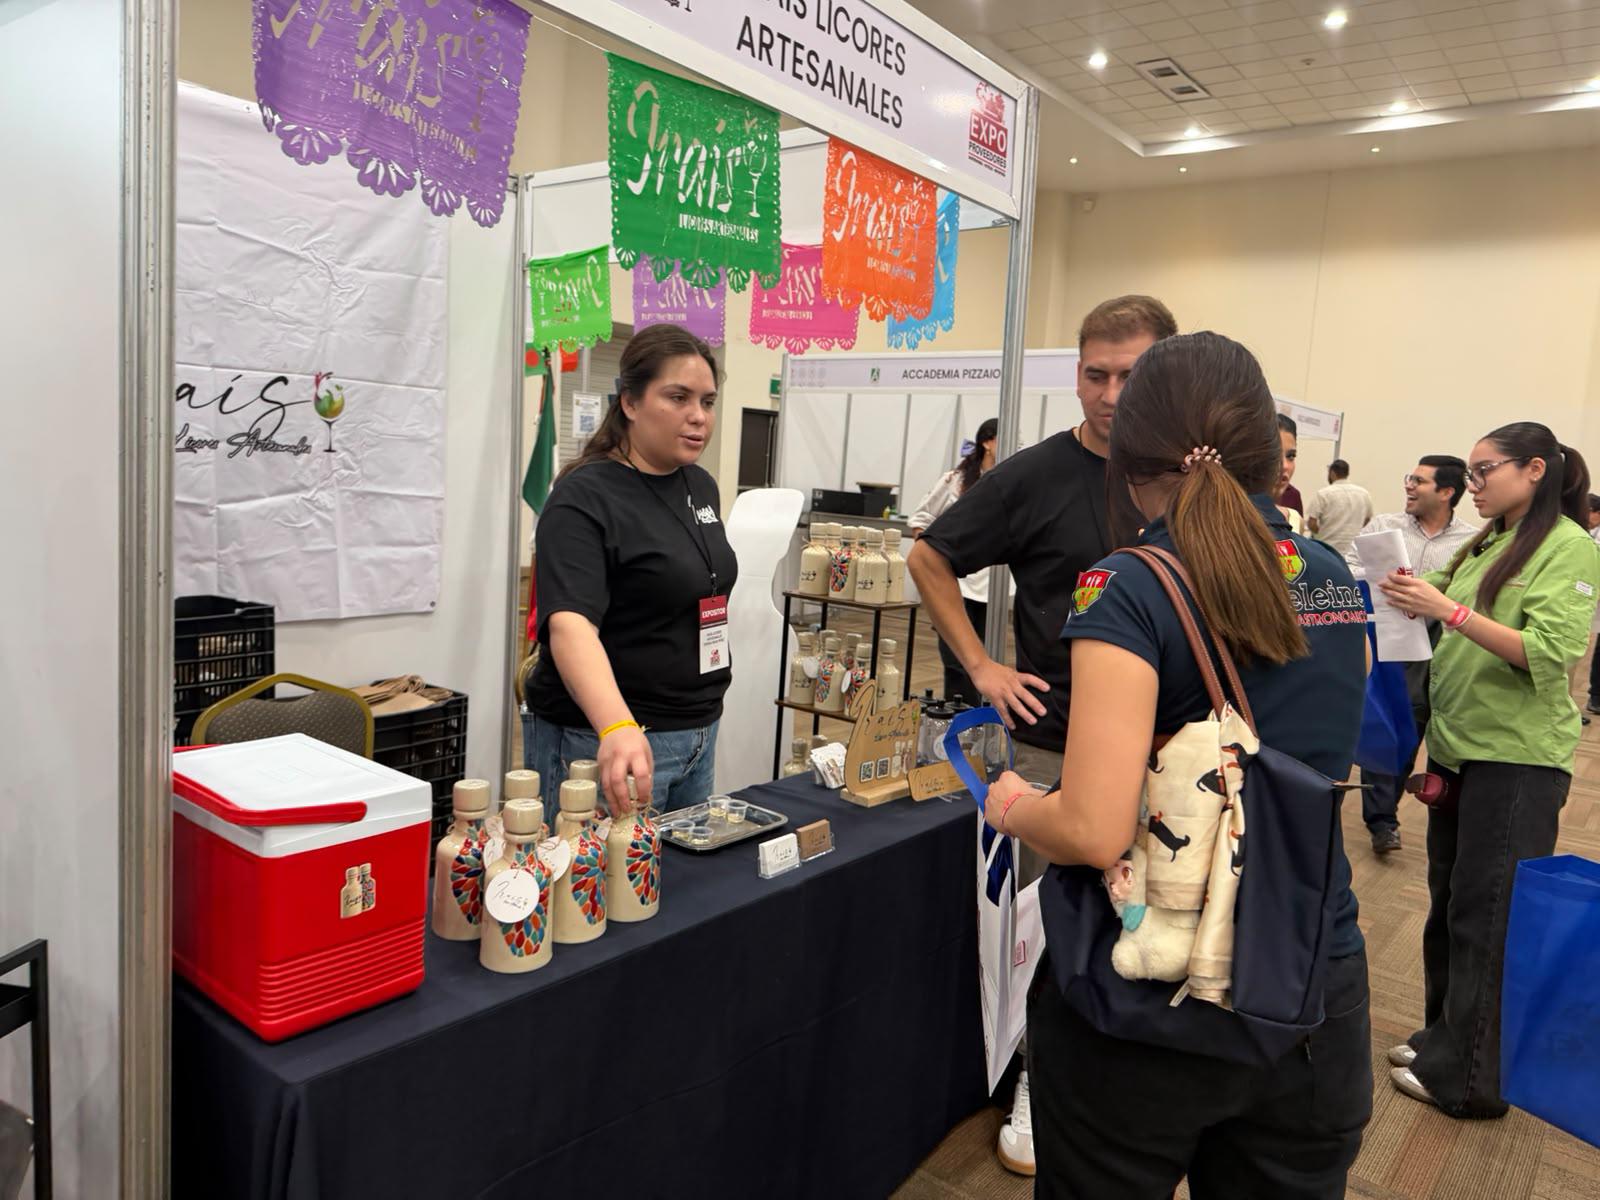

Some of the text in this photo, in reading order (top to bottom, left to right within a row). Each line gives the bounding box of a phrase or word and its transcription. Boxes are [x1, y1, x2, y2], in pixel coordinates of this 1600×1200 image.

[815, 0, 906, 76] LICORES
[736, 15, 903, 129] ARTESANALES
[970, 113, 1007, 153] EXPO
[968, 141, 1007, 169] PROVEEDORES
[902, 368, 960, 380] ACCADEMIA
[701, 607, 726, 619] EXPOSITOR
